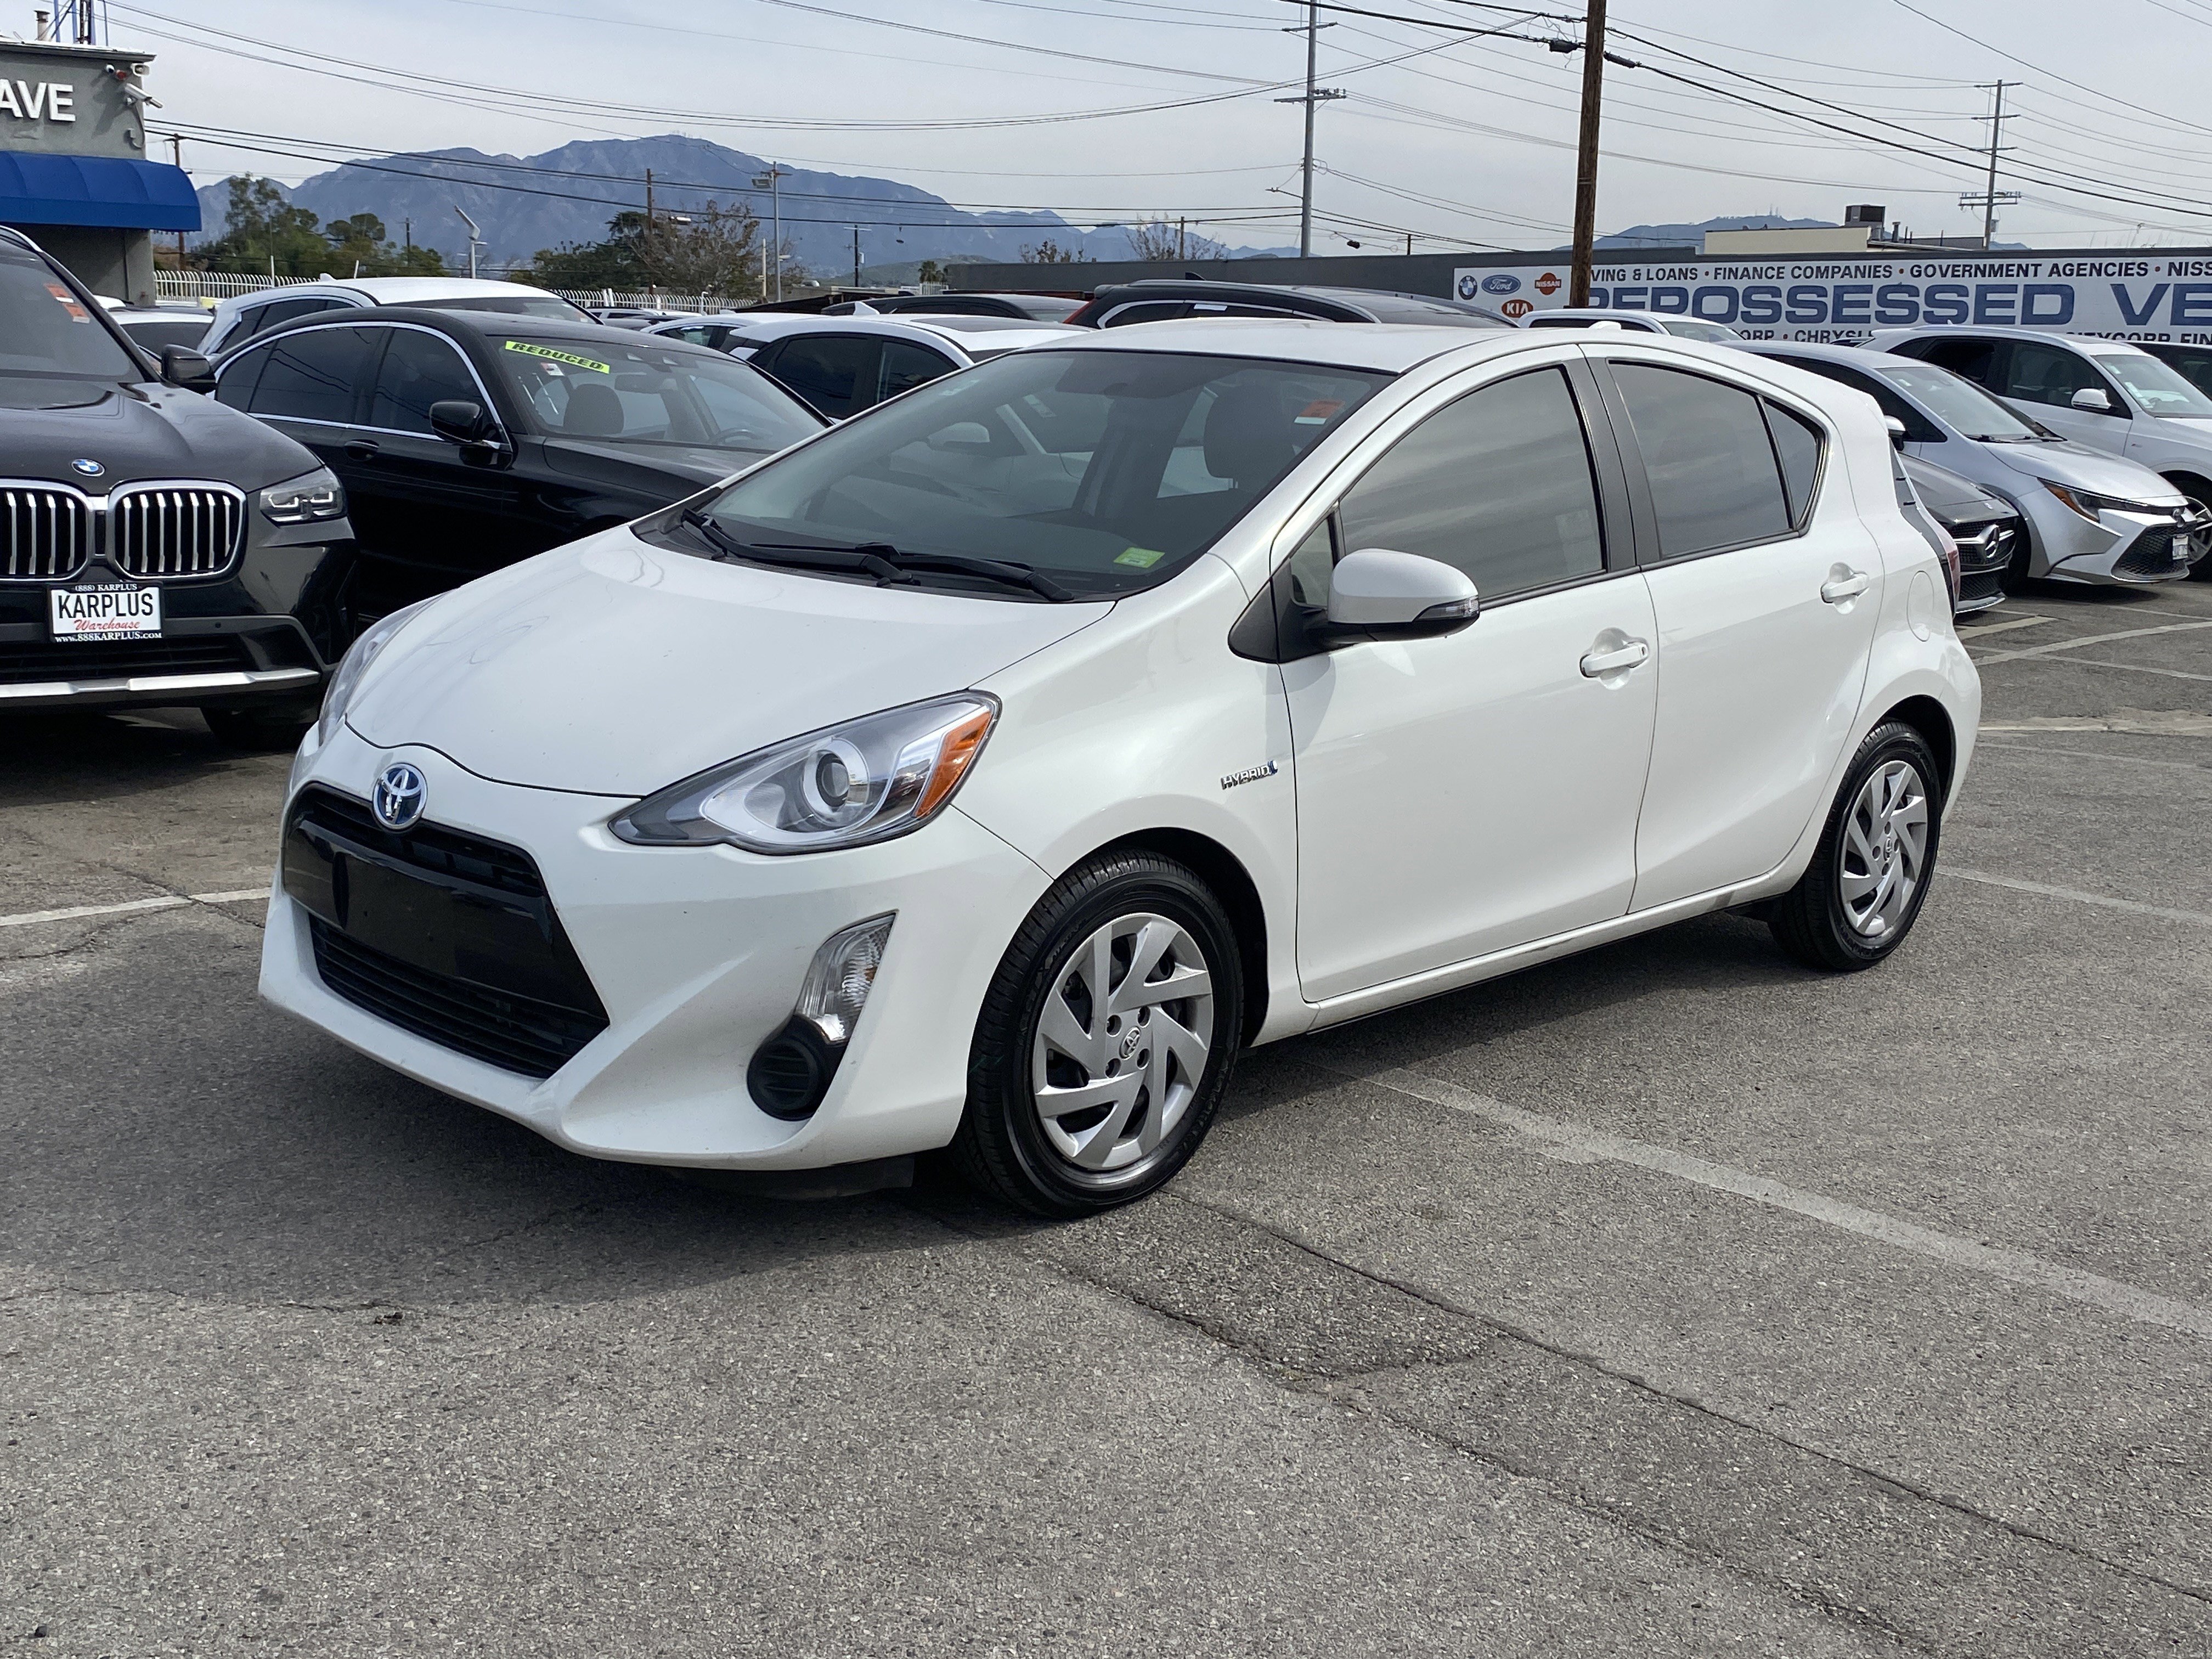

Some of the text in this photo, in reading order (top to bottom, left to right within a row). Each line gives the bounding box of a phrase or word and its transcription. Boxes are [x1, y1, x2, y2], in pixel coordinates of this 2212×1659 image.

[0, 78, 76, 121] AVE
[1633, 269, 1641, 280] &
[1646, 267, 1698, 280] LOANS
[1714, 266, 1785, 280] FINANCE
[1791, 265, 1893, 279] COMPANIES
[1910, 263, 2042, 278] GOVERNMENT
[2048, 262, 2149, 277] AGENCIES
[1488, 278, 1513, 291] Ford
[1506, 302, 1529, 314] KIA
[512, 342, 603, 370] REDUCED
[98, 583, 138, 591] KARPLUS
[58, 592, 153, 619] KARPLUS
[74, 617, 140, 631] Warehouse
[1221, 764, 1272, 790] HYBRID
